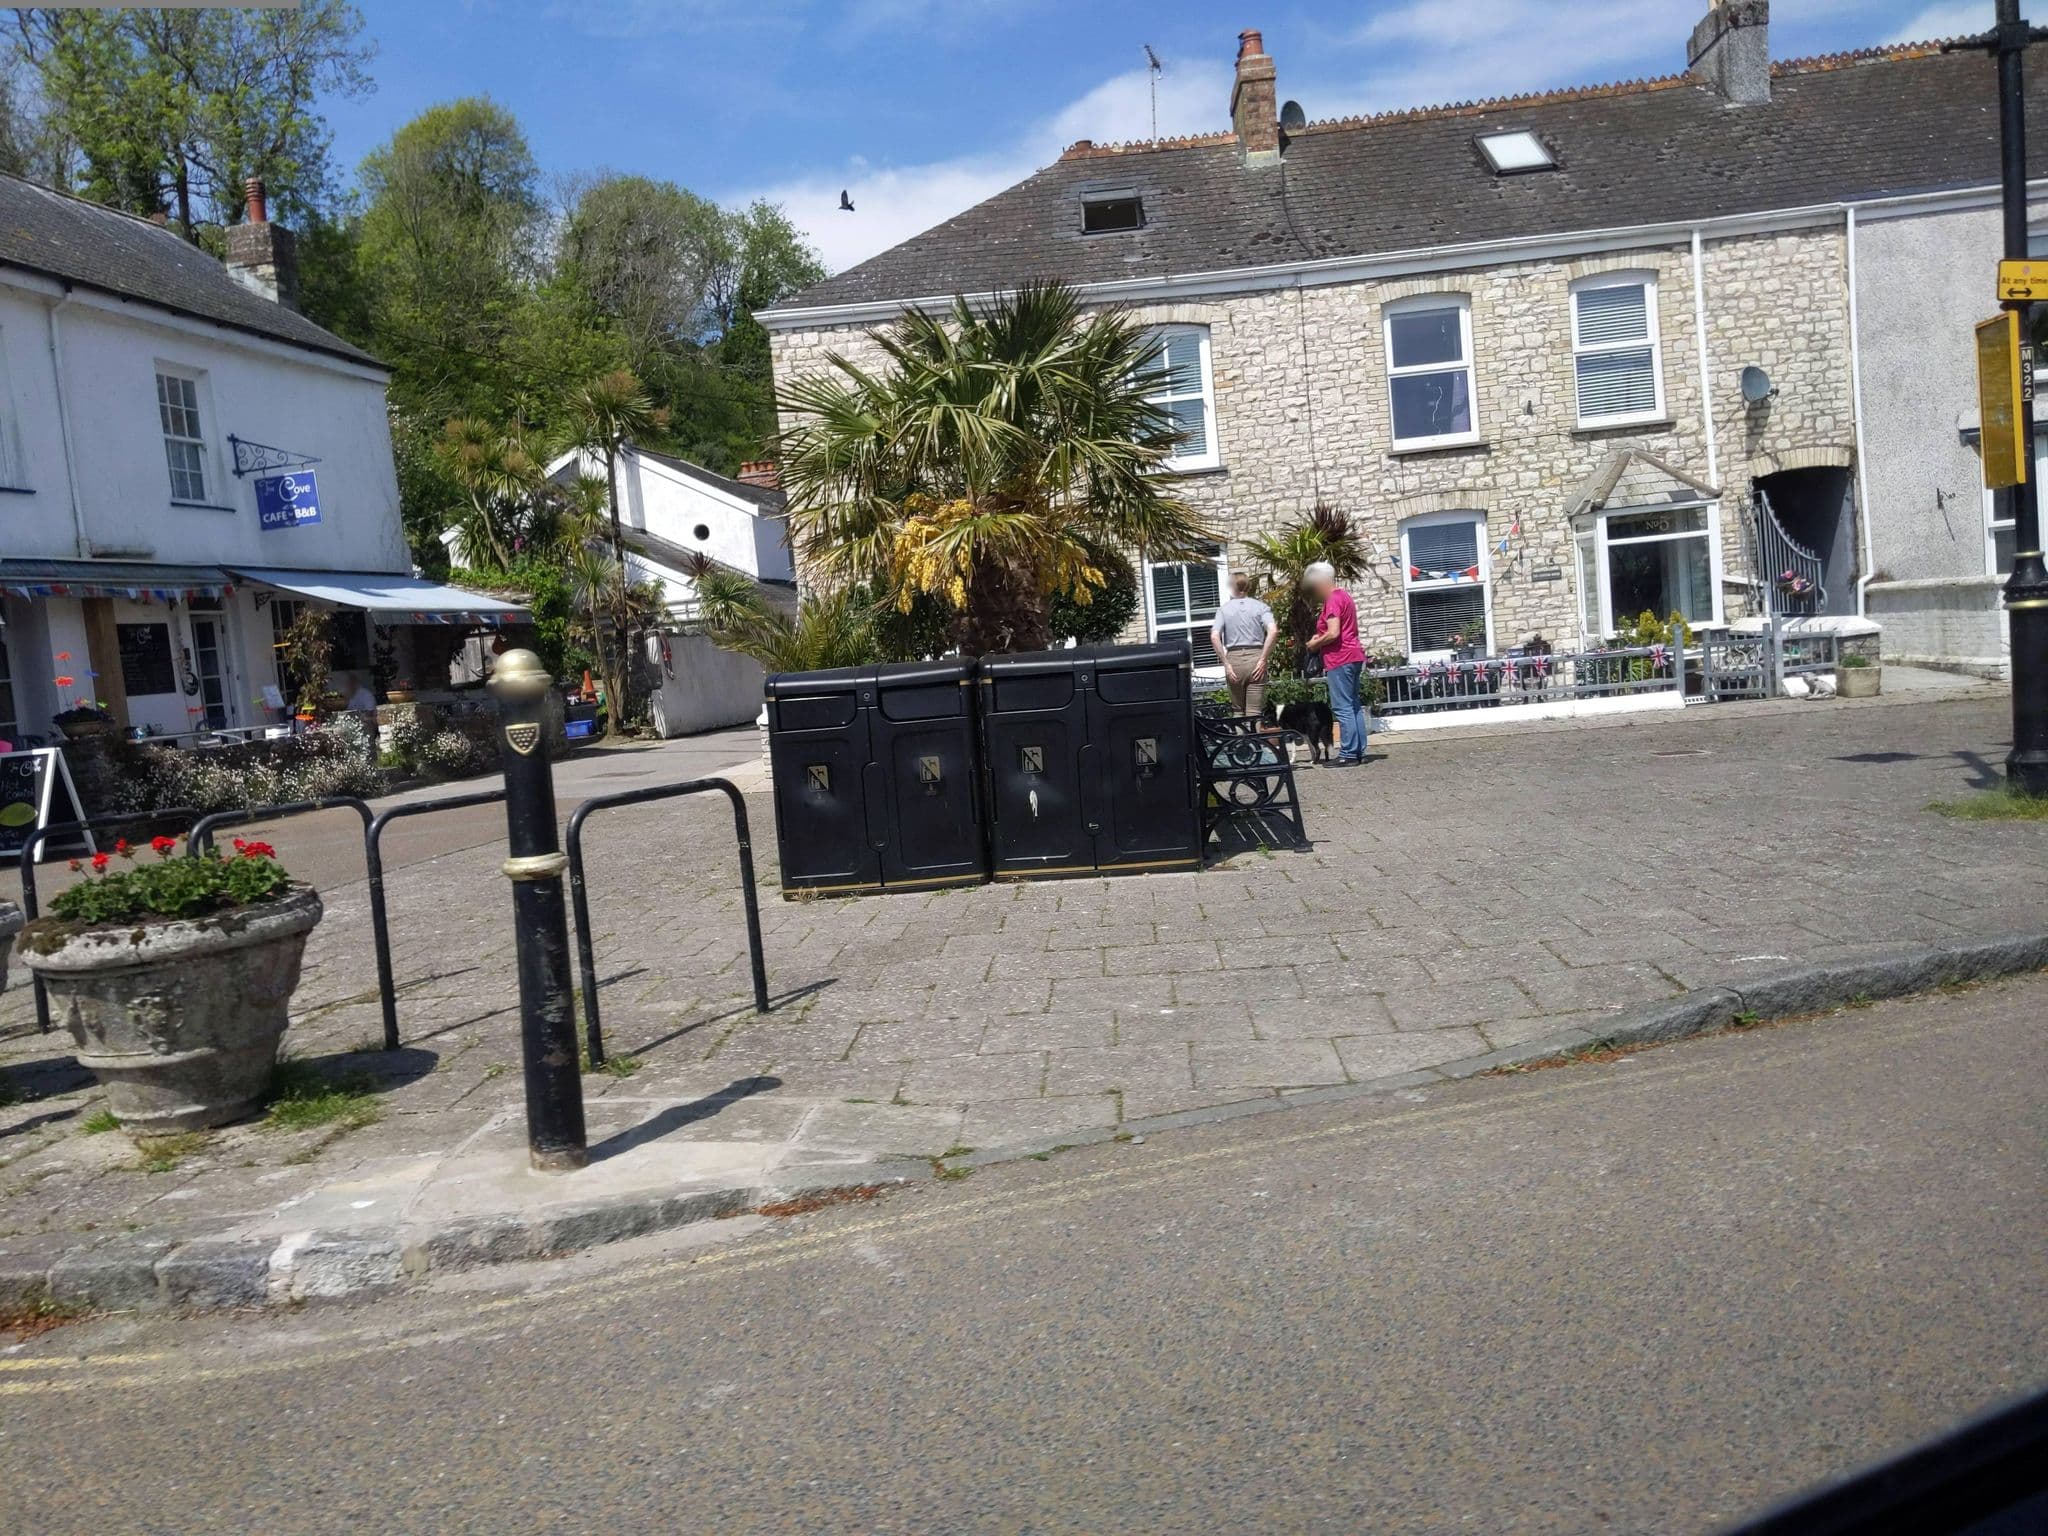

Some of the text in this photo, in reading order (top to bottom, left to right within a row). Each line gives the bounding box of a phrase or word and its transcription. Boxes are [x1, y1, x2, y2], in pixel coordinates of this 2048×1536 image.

[2013, 278, 2026, 286] any
[2021, 349, 2032, 398] M322
[279, 476, 311, 502] Cove
[263, 506, 317, 523] CAFE B&B
[1549, 557, 1555, 566] 5
